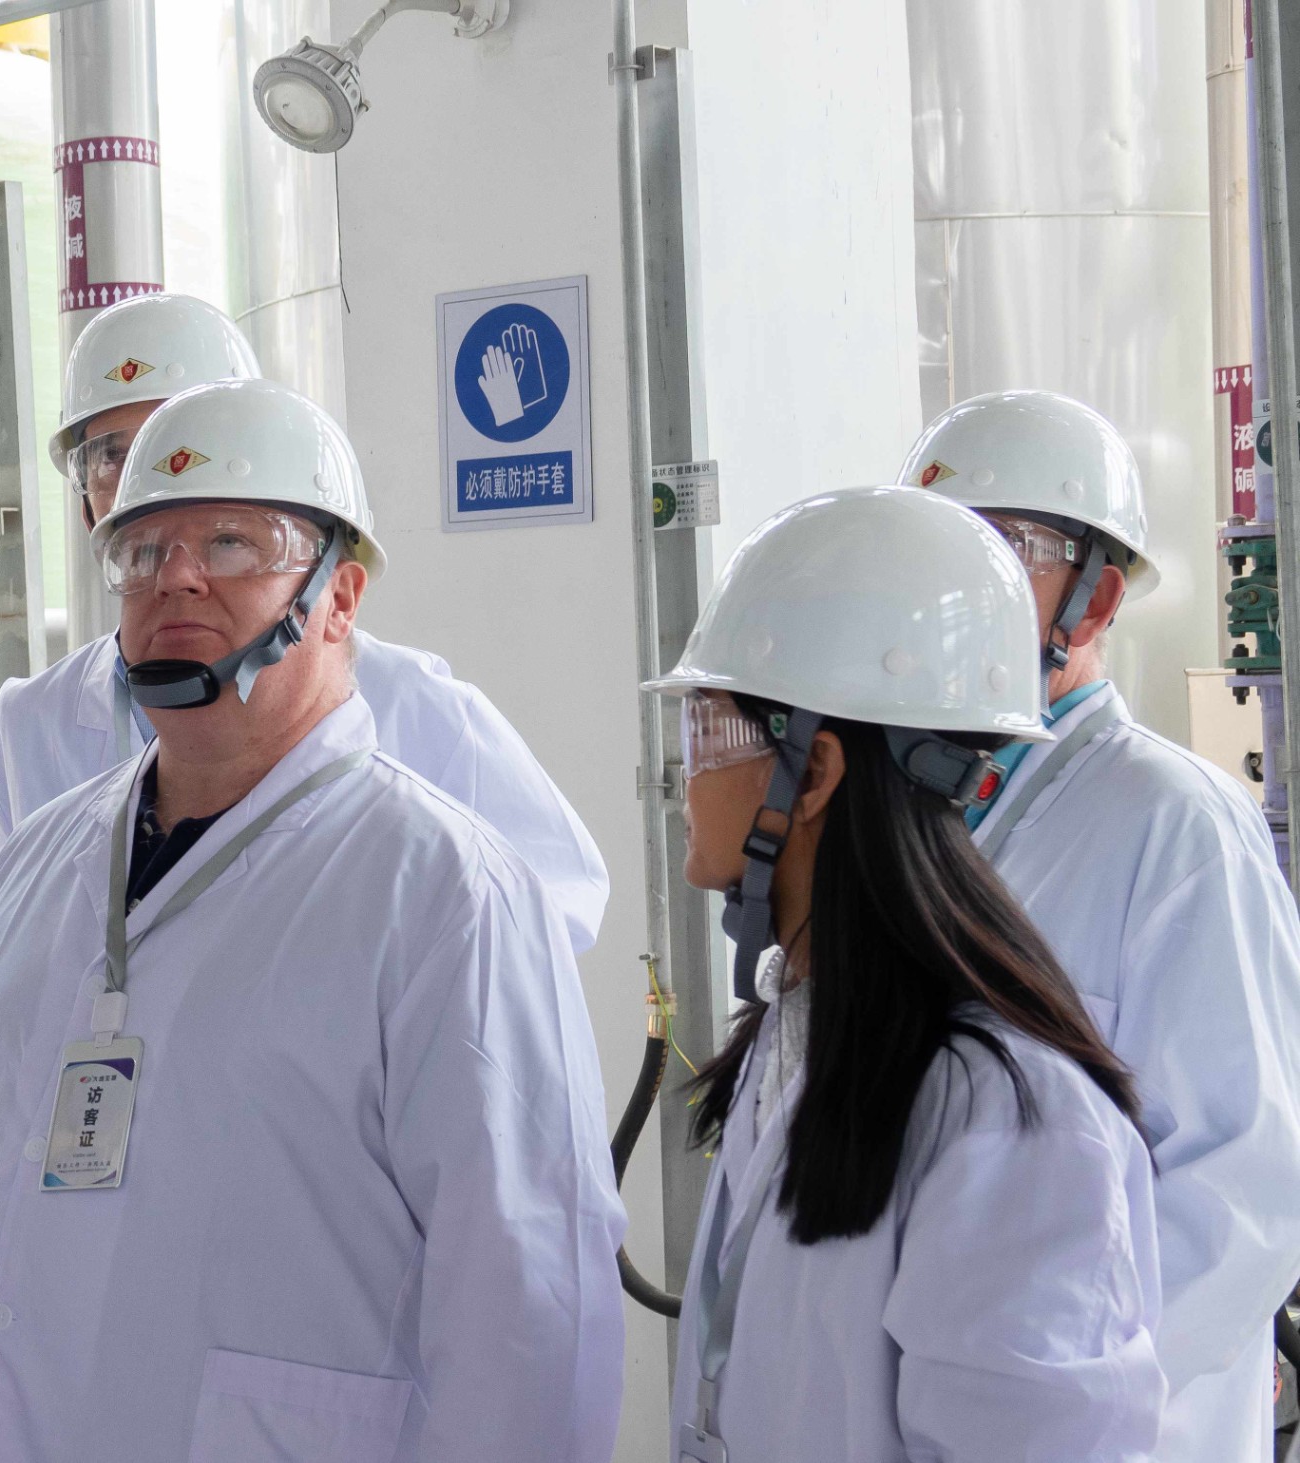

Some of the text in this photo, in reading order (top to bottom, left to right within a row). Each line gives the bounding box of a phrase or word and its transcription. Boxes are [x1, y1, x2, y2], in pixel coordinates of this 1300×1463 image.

[64, 194, 84, 260] 液碱
[465, 461, 565, 501] 必须戴防护手套
[79, 1086, 104, 1148] 访客证
